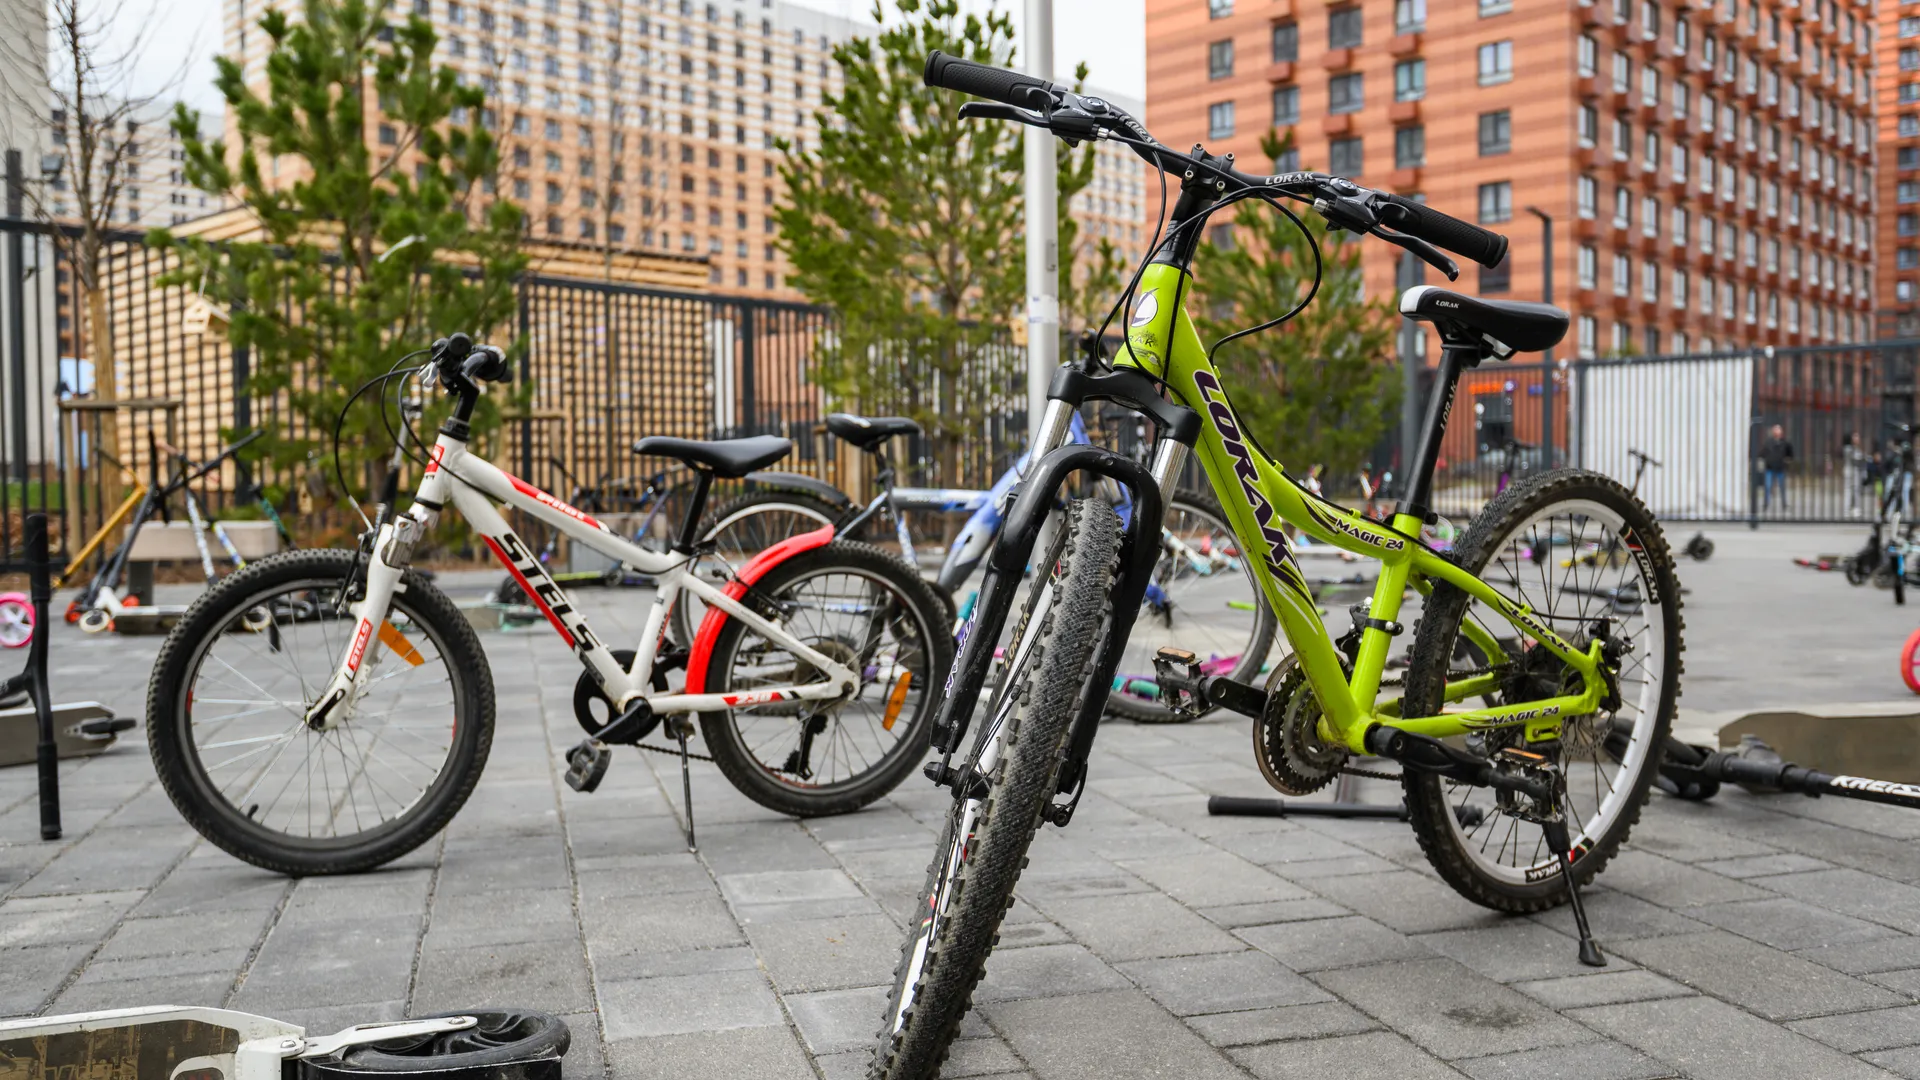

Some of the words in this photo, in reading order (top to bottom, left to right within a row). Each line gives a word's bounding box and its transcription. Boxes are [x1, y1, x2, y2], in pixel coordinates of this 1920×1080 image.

[1265, 172, 1314, 186] LORAK
[1435, 299, 1460, 309] LORAK
[1192, 369, 1299, 569] LORAK
[1335, 518, 1385, 547] MAGIC
[1384, 537, 1405, 551] 24
[492, 532, 601, 652] STELS
[1636, 551, 1659, 601] LORAK
[1004, 612, 1030, 670] LORAK
[1511, 608, 1572, 655] LORAK
[1491, 709, 1540, 726] MAGIC
[1541, 705, 1561, 718] 24
[1527, 860, 1562, 881] ORAK
